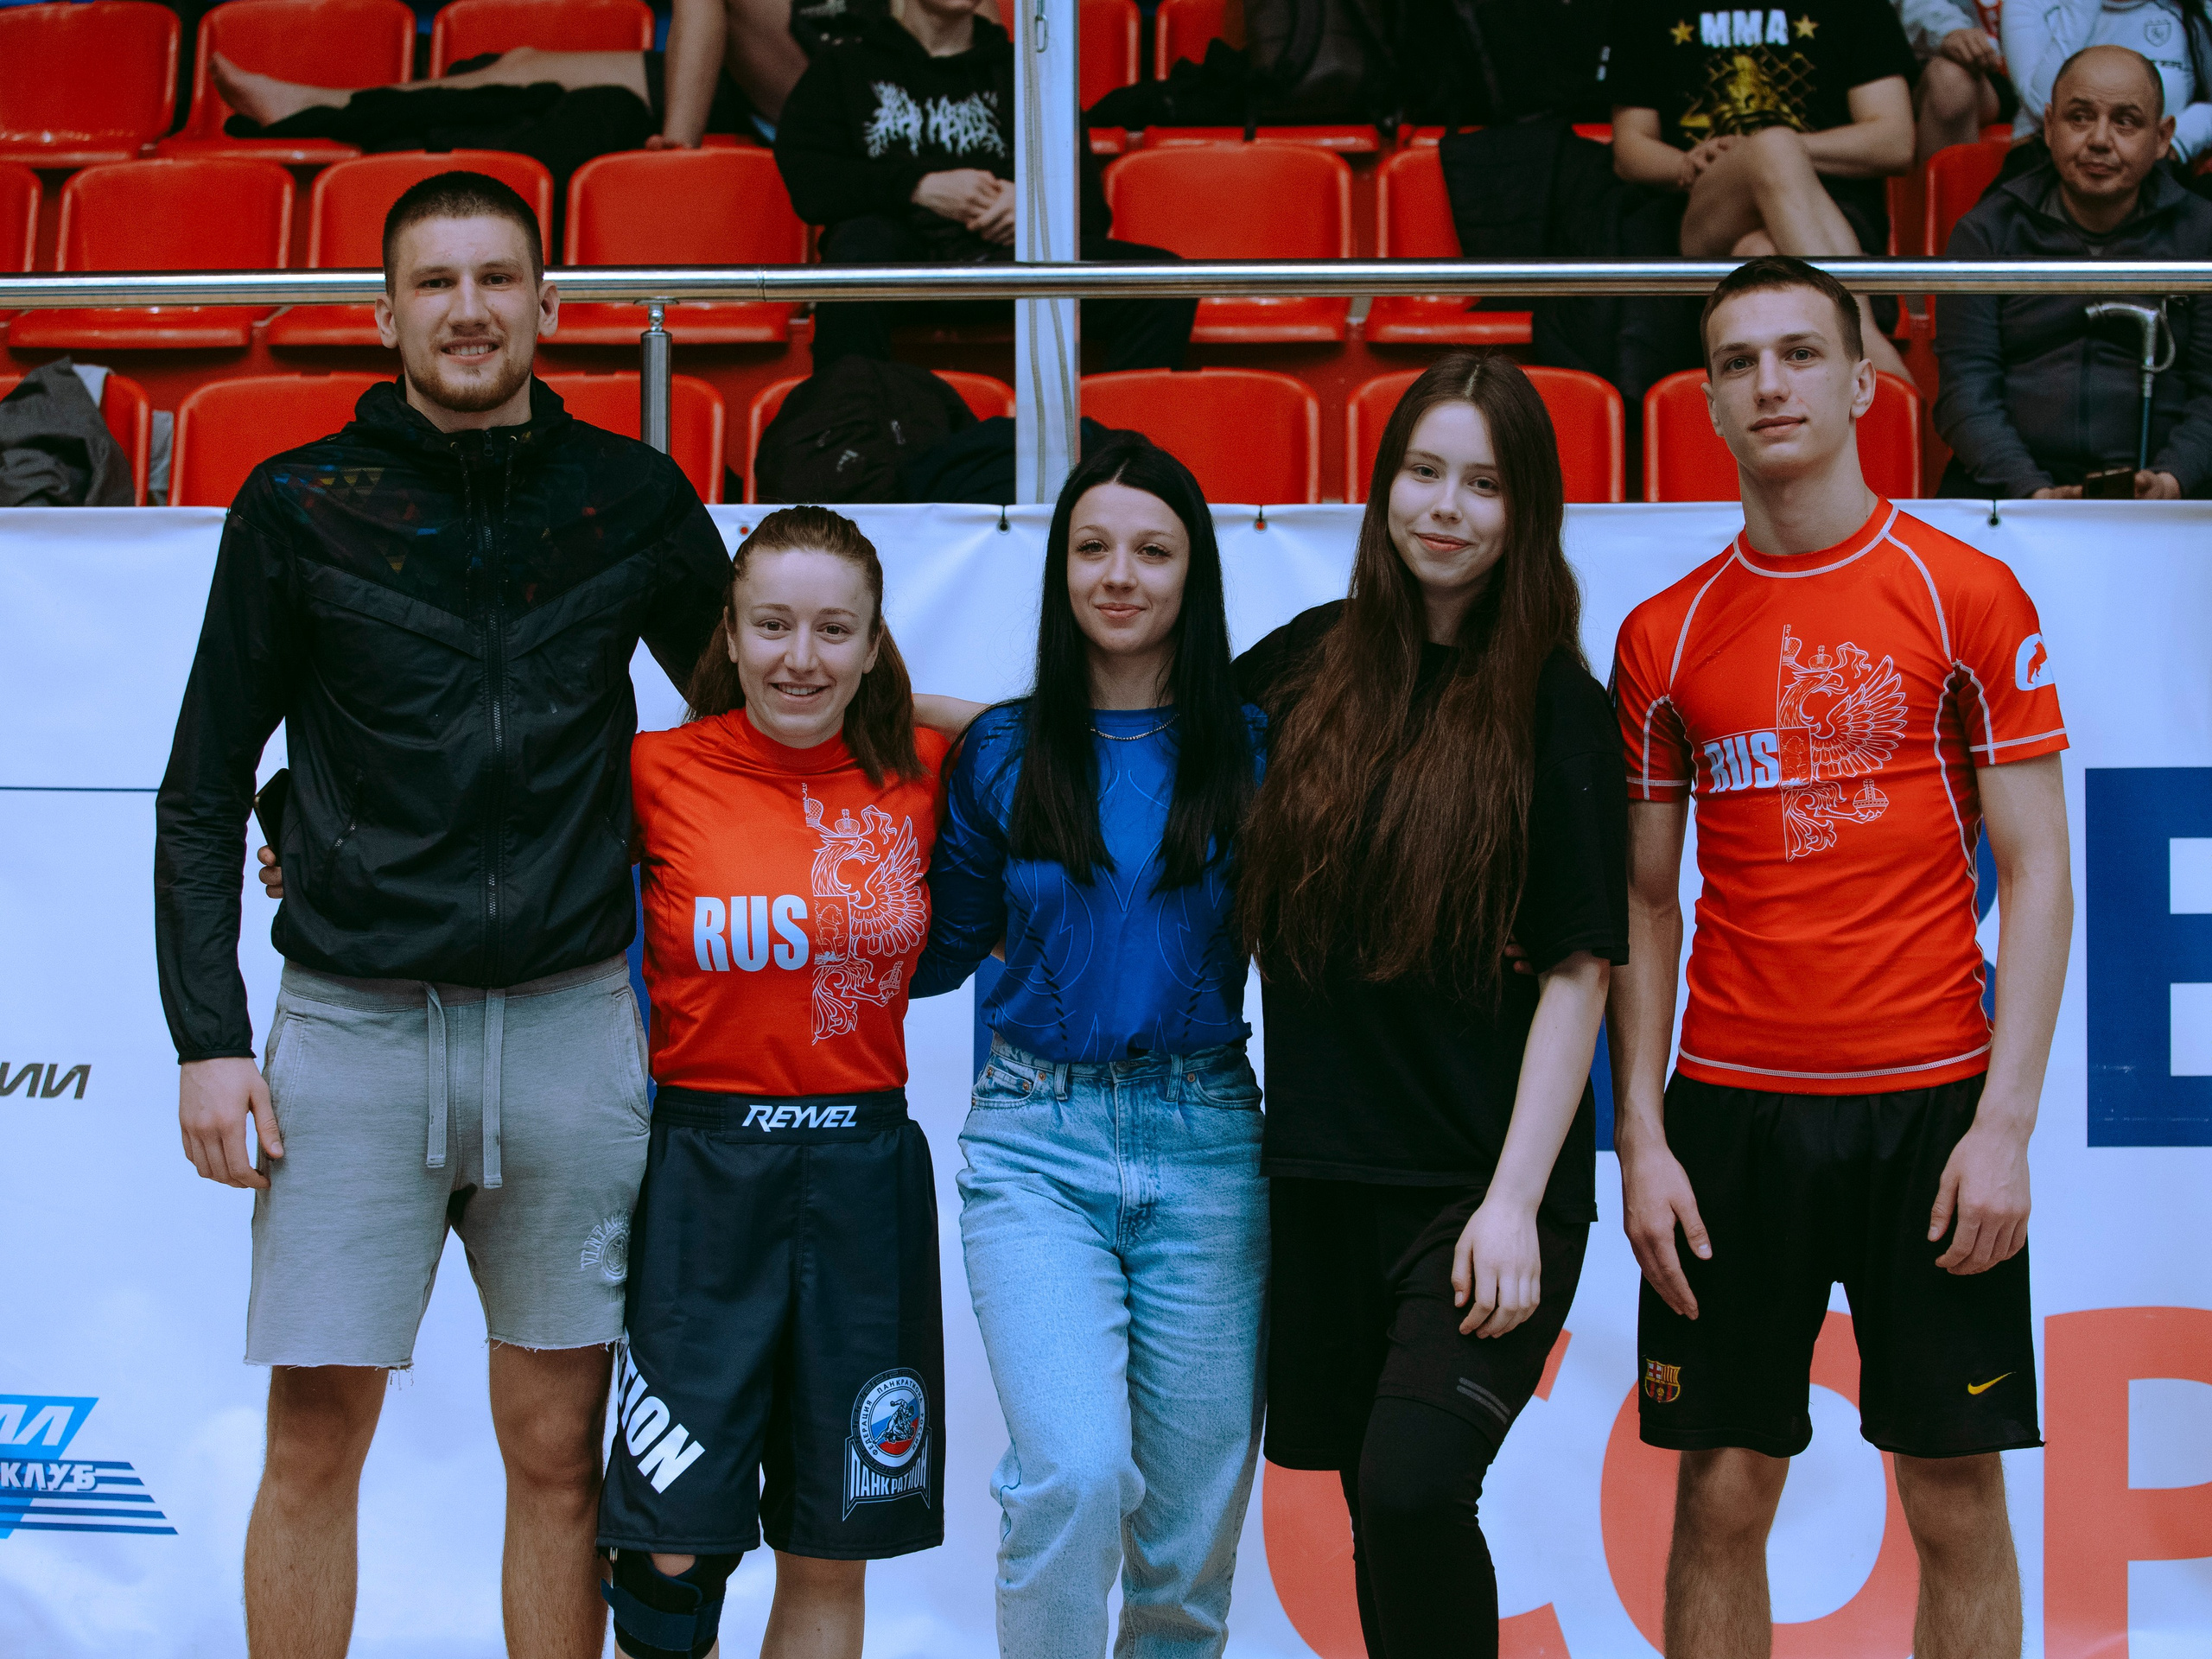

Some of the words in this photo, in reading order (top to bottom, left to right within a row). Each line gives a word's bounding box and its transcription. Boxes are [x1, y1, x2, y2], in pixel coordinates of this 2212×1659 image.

[1700, 9, 1789, 48] MMA
[1703, 732, 1780, 793] RUS
[694, 894, 809, 972] RUS
[861, 1400, 879, 1456] ФЕДЕРАЦИЯ
[876, 1379, 923, 1404] ПАНКРАТИОНА
[912, 1413, 925, 1452] РОССИИ
[0, 1461, 96, 1491] КЛУБ
[850, 1434, 929, 1502] ПАНКРАТИОН
